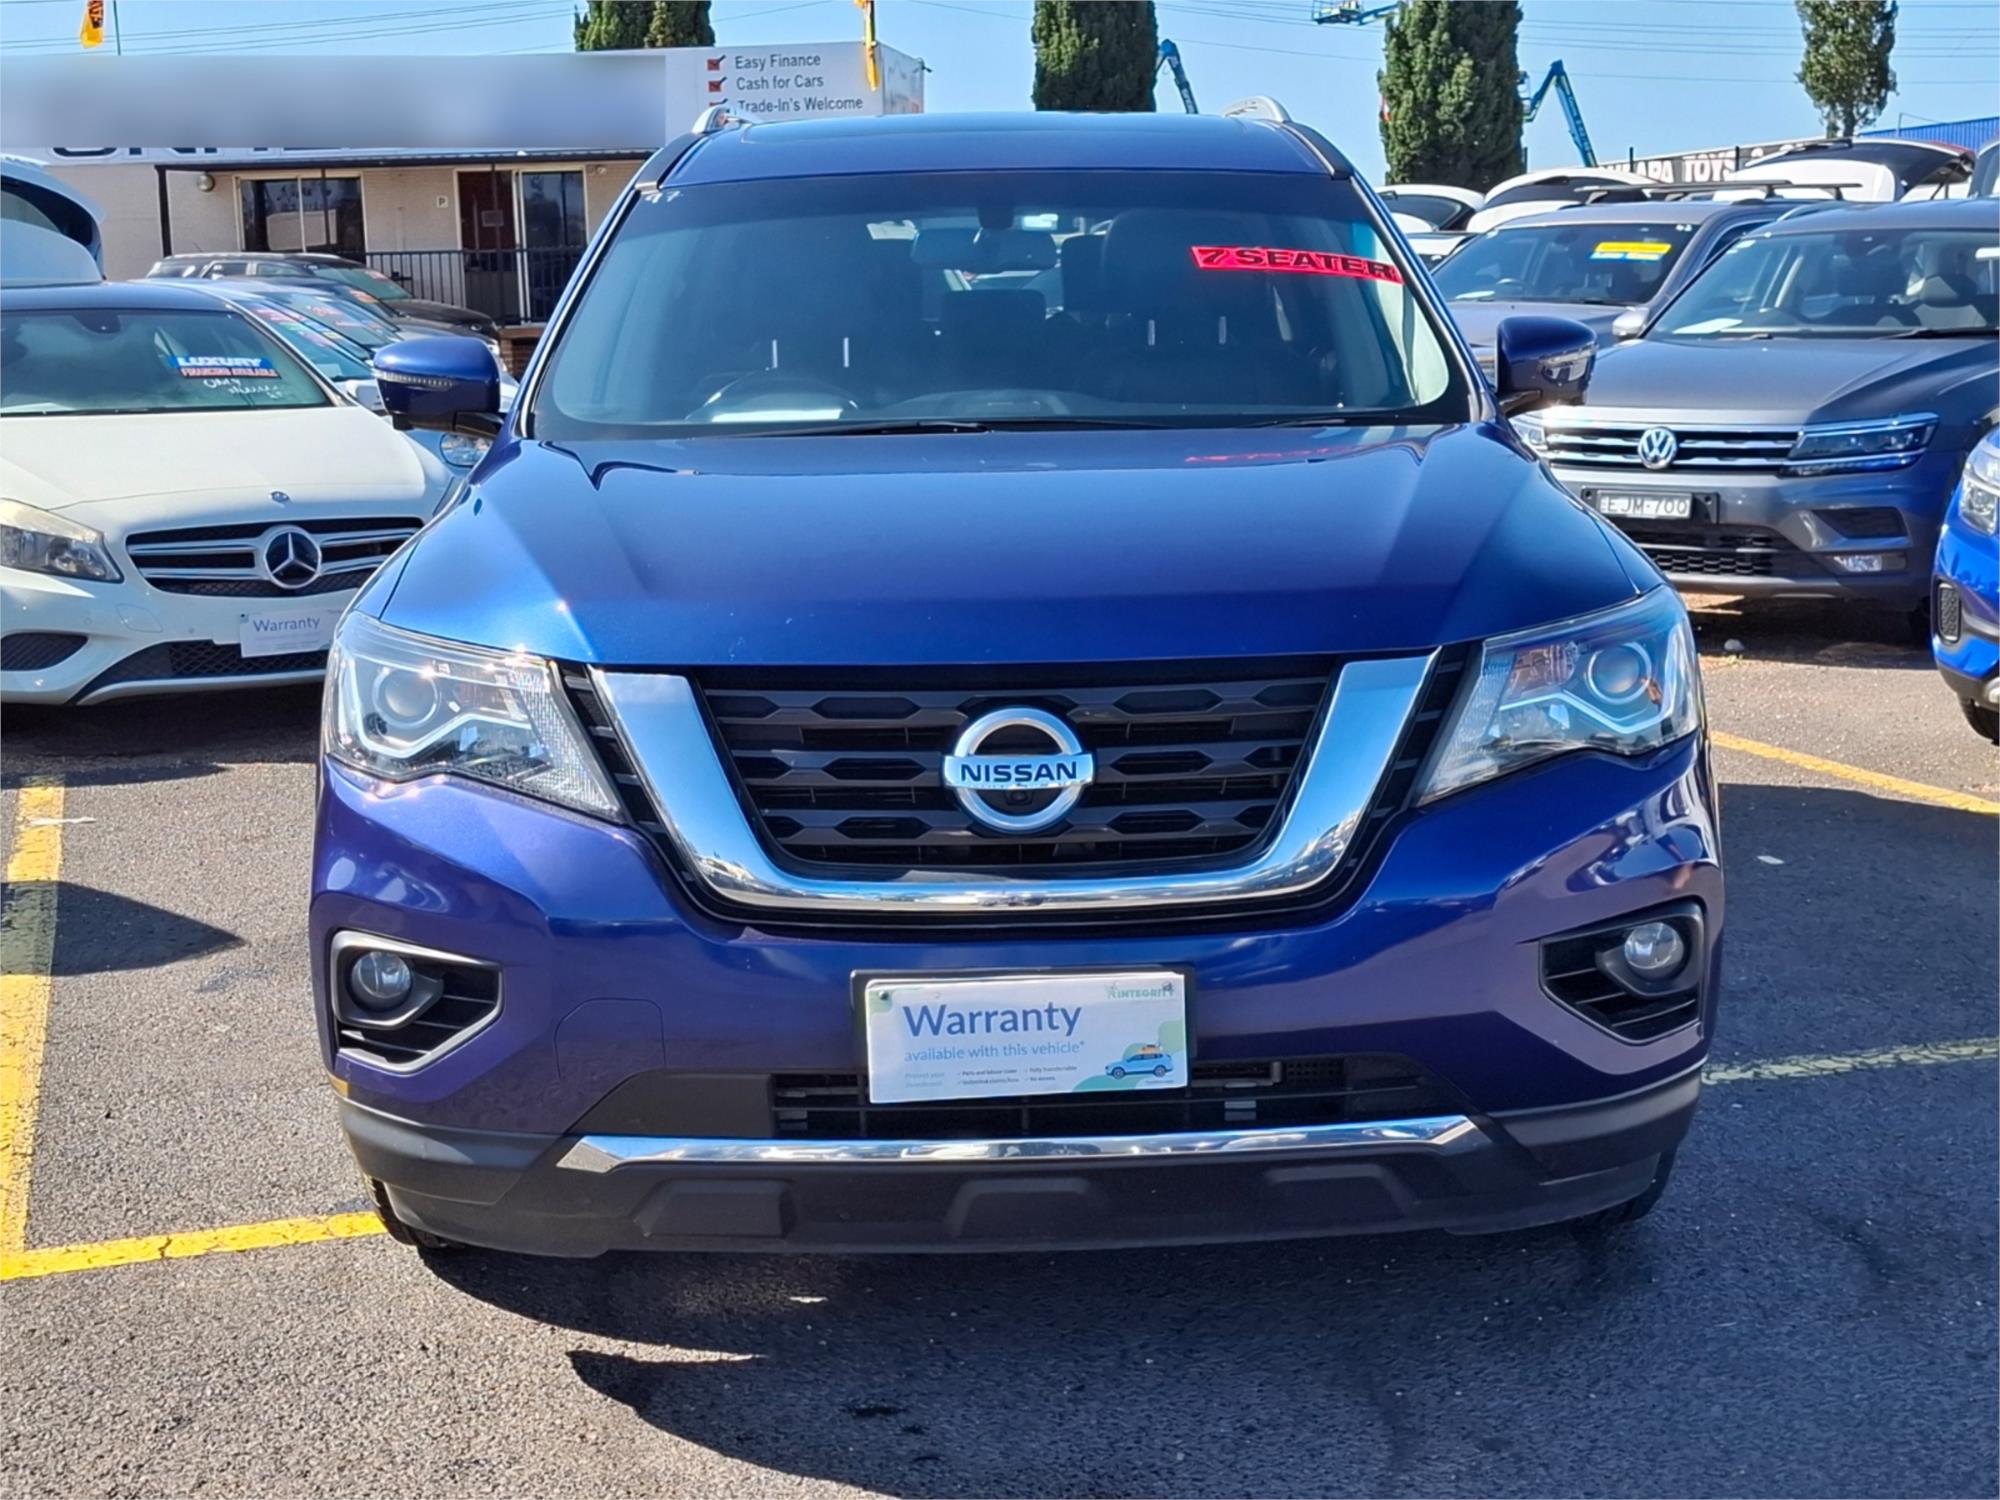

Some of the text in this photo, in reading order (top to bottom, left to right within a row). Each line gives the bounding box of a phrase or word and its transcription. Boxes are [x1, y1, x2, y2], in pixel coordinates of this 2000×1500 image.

[735, 54, 821, 71] Easy Finance
[736, 74, 825, 90] Cash for Cars
[738, 97, 863, 113] Trade-In's Welcome
[1202, 249, 1393, 279] 7 SEATER
[176, 356, 263, 368] LUXURY
[253, 617, 321, 632] Warranty
[961, 761, 1077, 782] NISSAN
[903, 1002, 1082, 1037] Warranty
[904, 1046, 965, 1062] available
[968, 1044, 999, 1059] with
[1003, 1043, 1028, 1057] this
